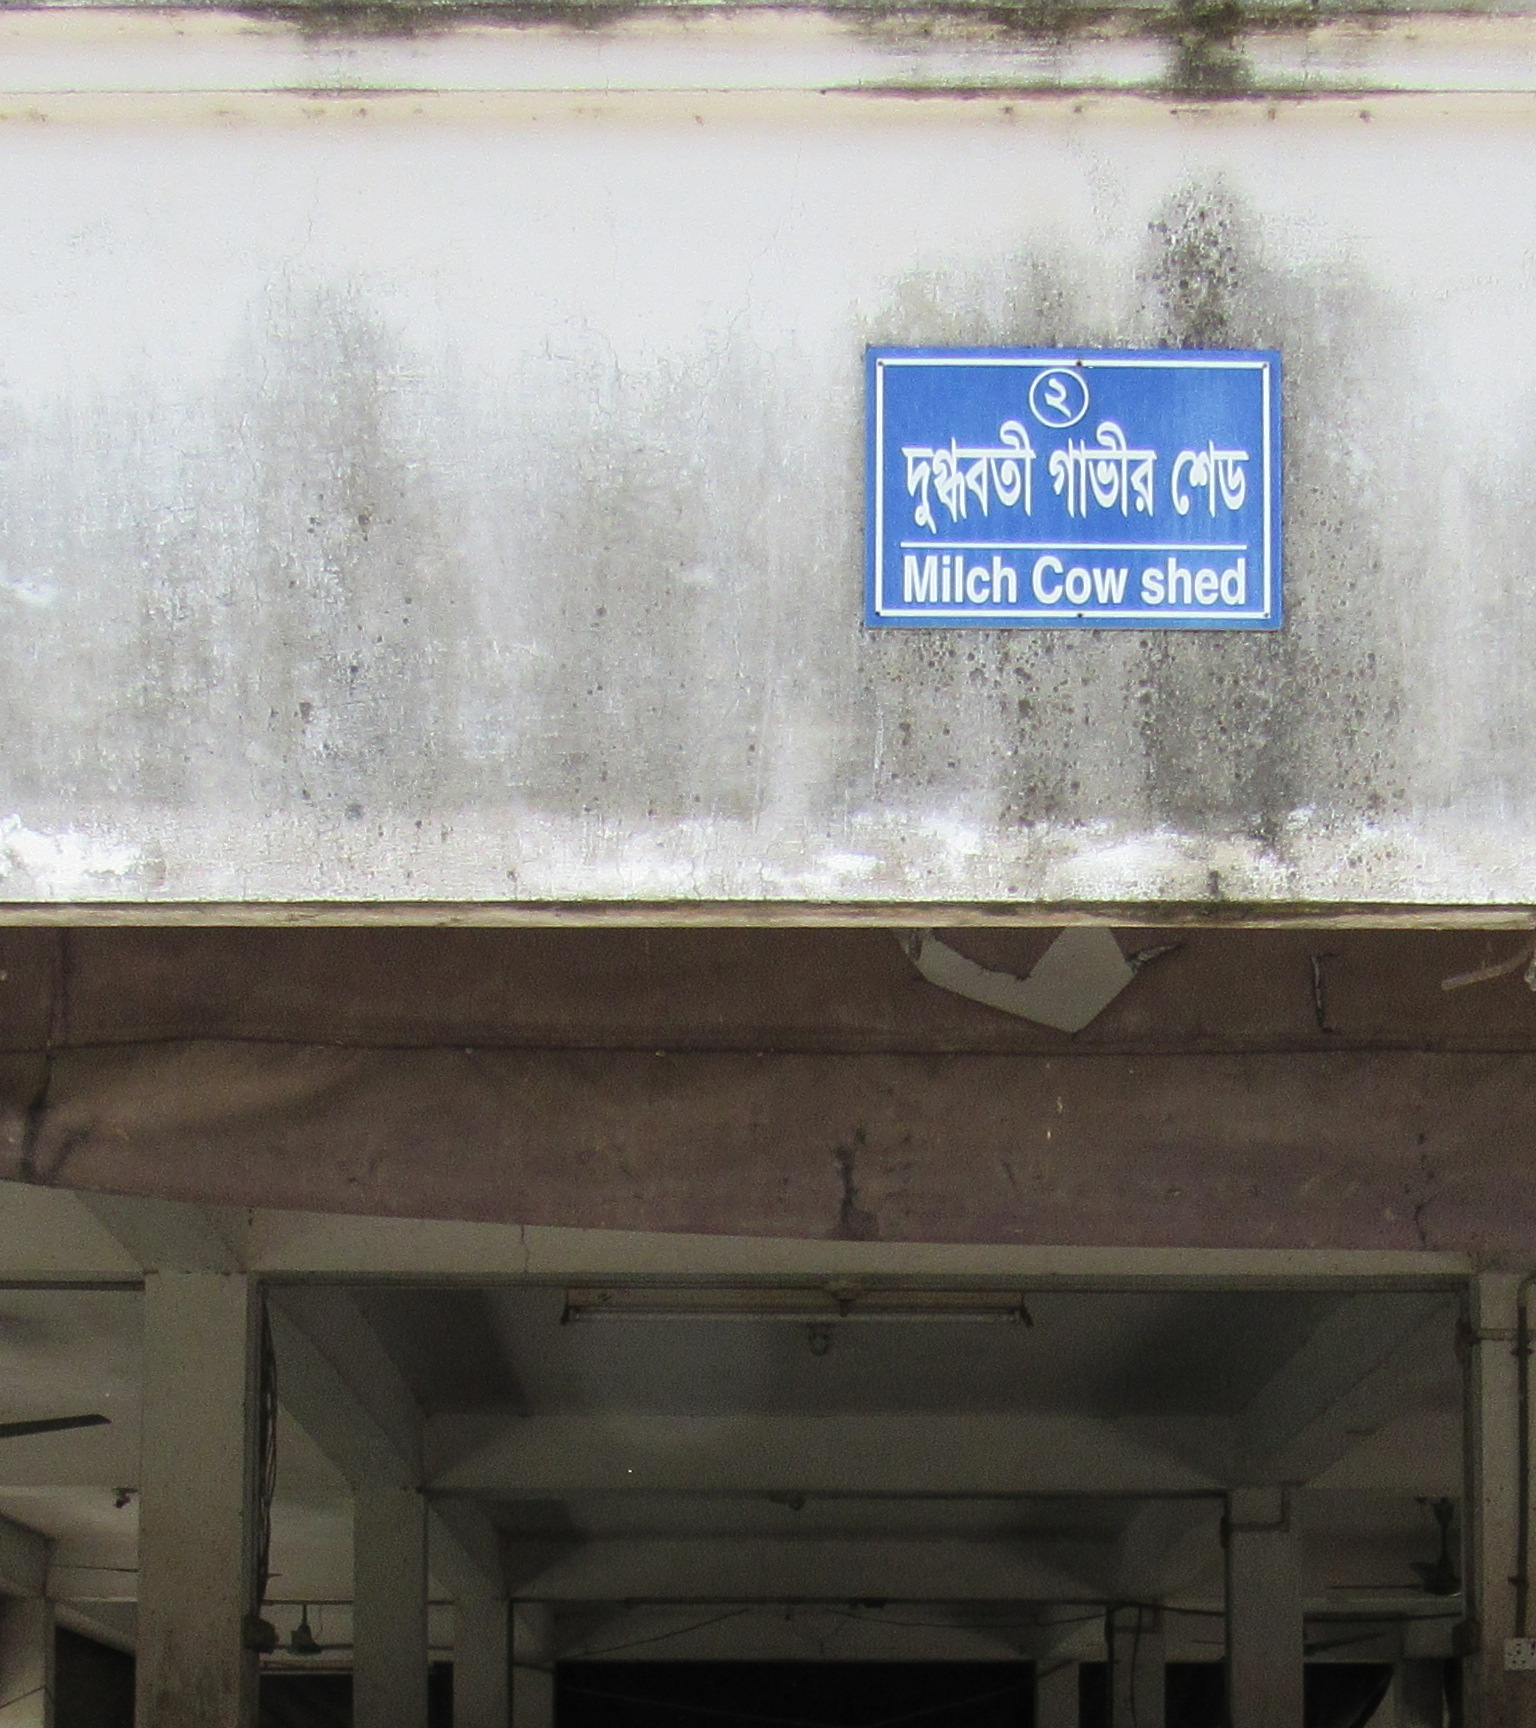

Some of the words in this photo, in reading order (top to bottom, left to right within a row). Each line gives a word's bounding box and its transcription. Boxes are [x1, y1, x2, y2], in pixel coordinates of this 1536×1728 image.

[1044, 377, 1072, 418] ২
[901, 420, 1037, 534] দুগ্ধবতী
[1048, 420, 1158, 518] গাভীর
[1171, 440, 1250, 518] শেড
[902, 554, 1017, 604] Milch
[1032, 554, 1129, 605] Cow
[1141, 556, 1246, 606] shed
